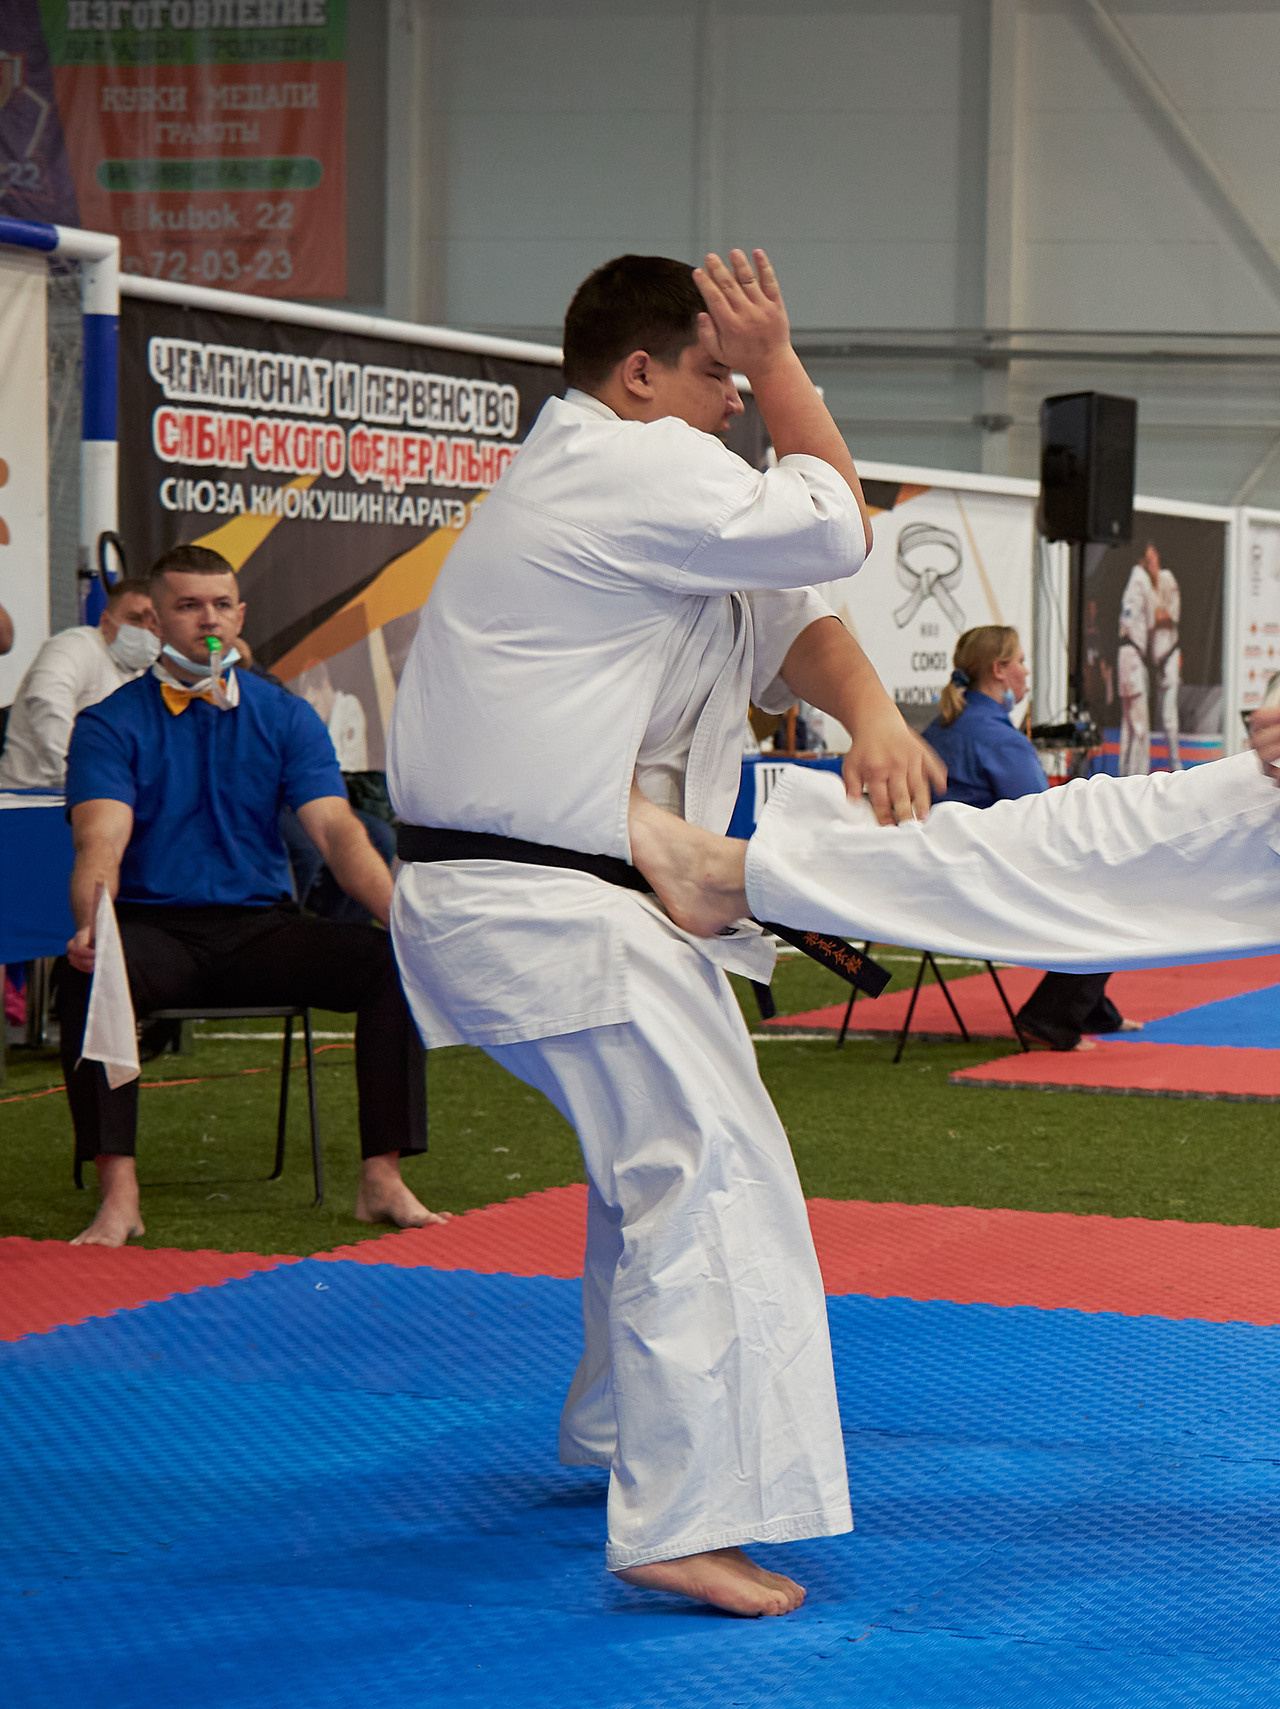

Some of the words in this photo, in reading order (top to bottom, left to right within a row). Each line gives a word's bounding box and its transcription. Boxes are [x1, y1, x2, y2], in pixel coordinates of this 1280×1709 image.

[66, 0, 327, 31] ИЗГОТОВЛЕНИЕ
[101, 86, 187, 112] КУБКИ
[208, 82, 319, 111] МЕДАЛИ
[155, 122, 260, 145] ГРАМОТЫ
[151, 249, 294, 282] 72-03-23
[152, 340, 330, 412] ЧЕМПИОНАТ
[336, 366, 358, 416] И
[363, 370, 517, 434] ПЕРВЕНСТВО
[156, 409, 343, 475] СИБИРСКОГО
[910, 651, 948, 672] СОЮЗ
